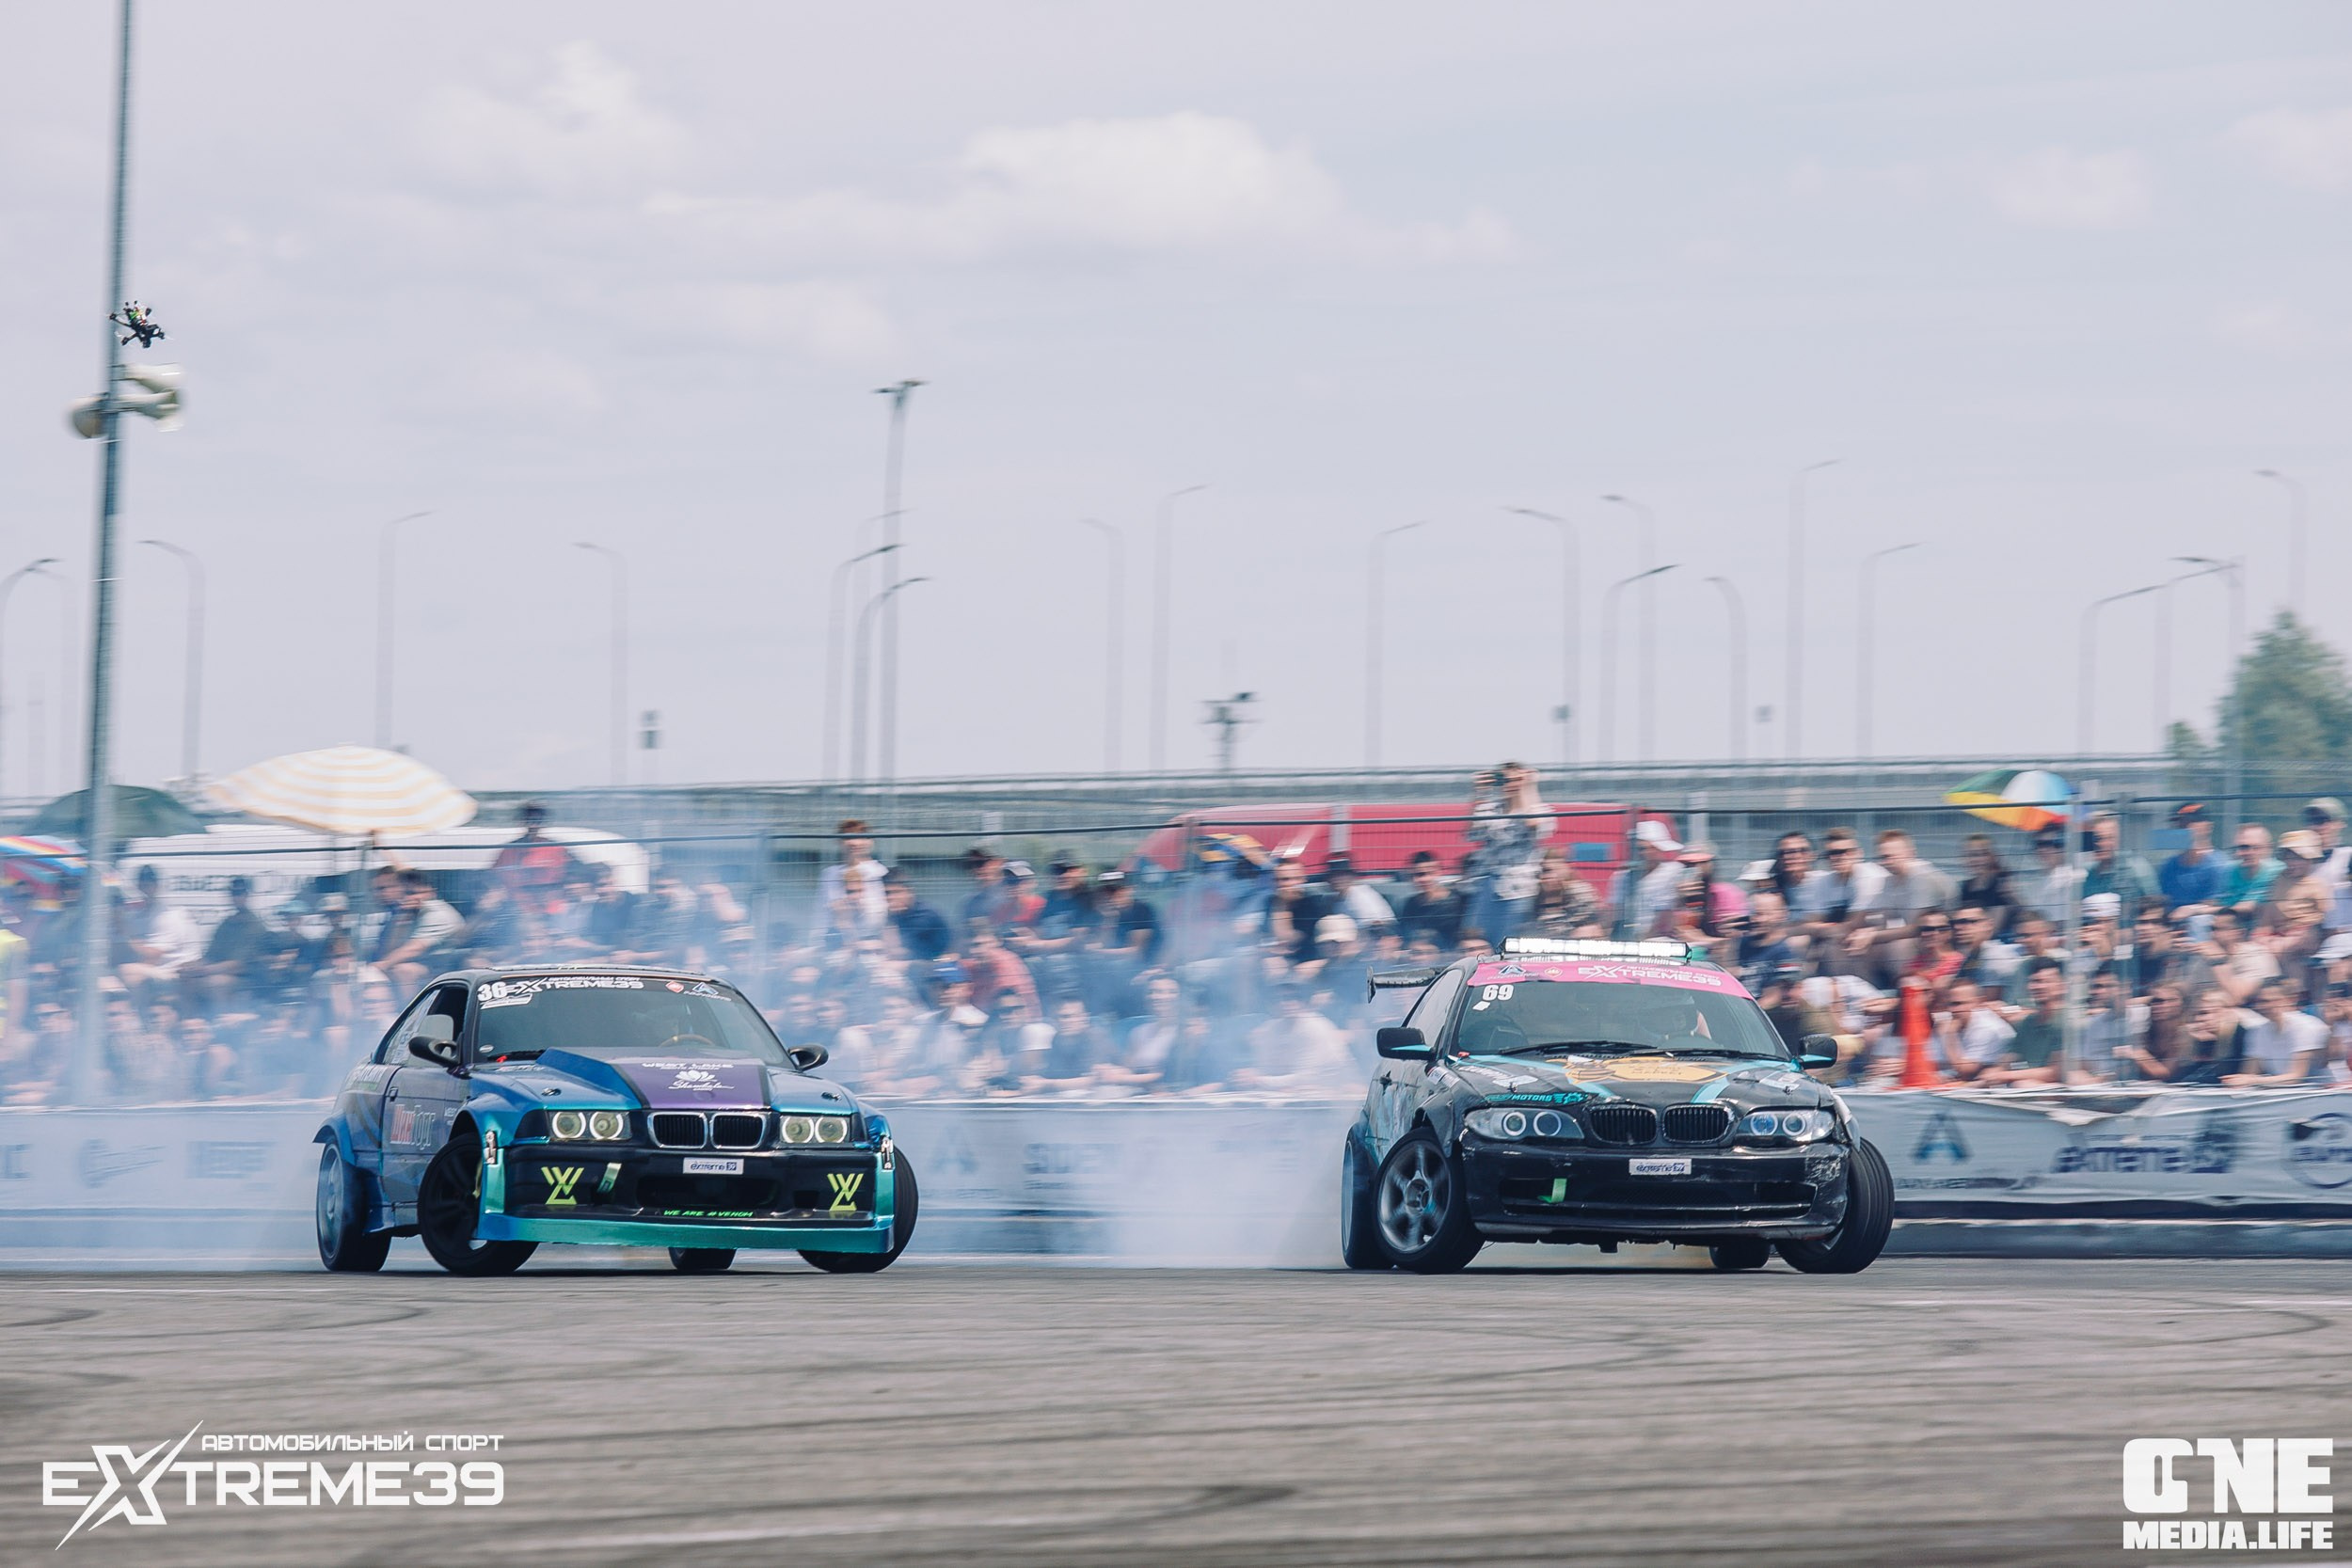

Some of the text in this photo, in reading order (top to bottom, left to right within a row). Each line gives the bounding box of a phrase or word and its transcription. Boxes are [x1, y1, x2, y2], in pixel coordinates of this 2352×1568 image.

[1577, 964, 1723, 987] EXTREME39
[477, 981, 507, 1002] 36
[1482, 984, 1514, 1002] 69
[1511, 1093, 1552, 1102] MOTORS
